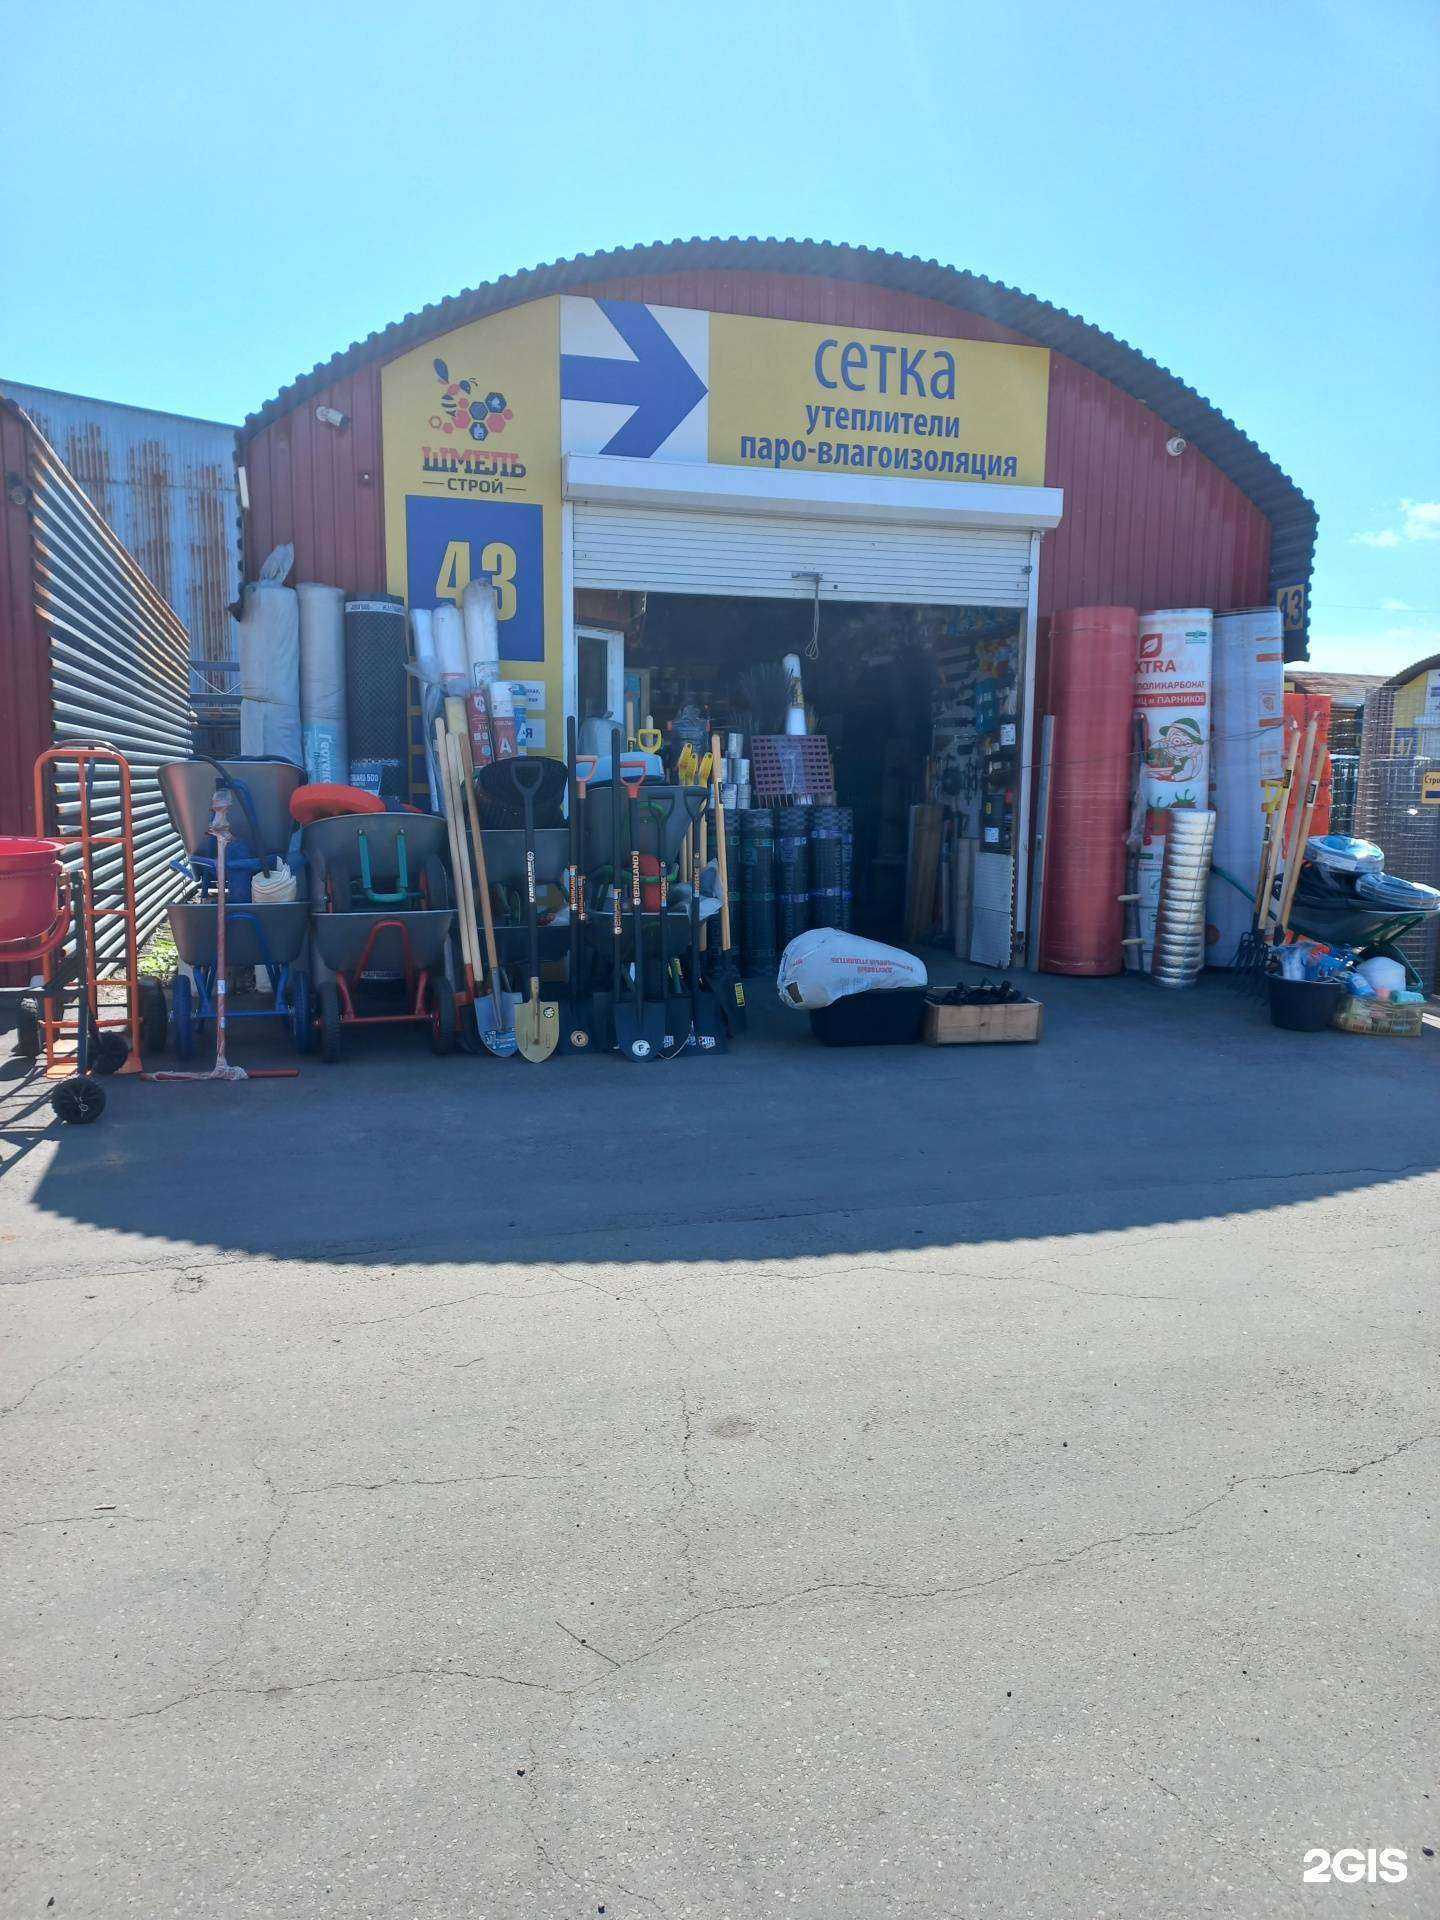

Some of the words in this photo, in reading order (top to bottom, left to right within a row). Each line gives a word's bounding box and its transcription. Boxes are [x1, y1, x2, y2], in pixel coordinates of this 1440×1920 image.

[814, 338, 956, 400] сетка
[805, 404, 960, 438] утеплители
[421, 446, 527, 478] ШМЕЛЬ
[740, 435, 1018, 480] паро-влагоизоляция
[446, 478, 504, 494] СТРОЙ
[435, 540, 517, 622] 43
